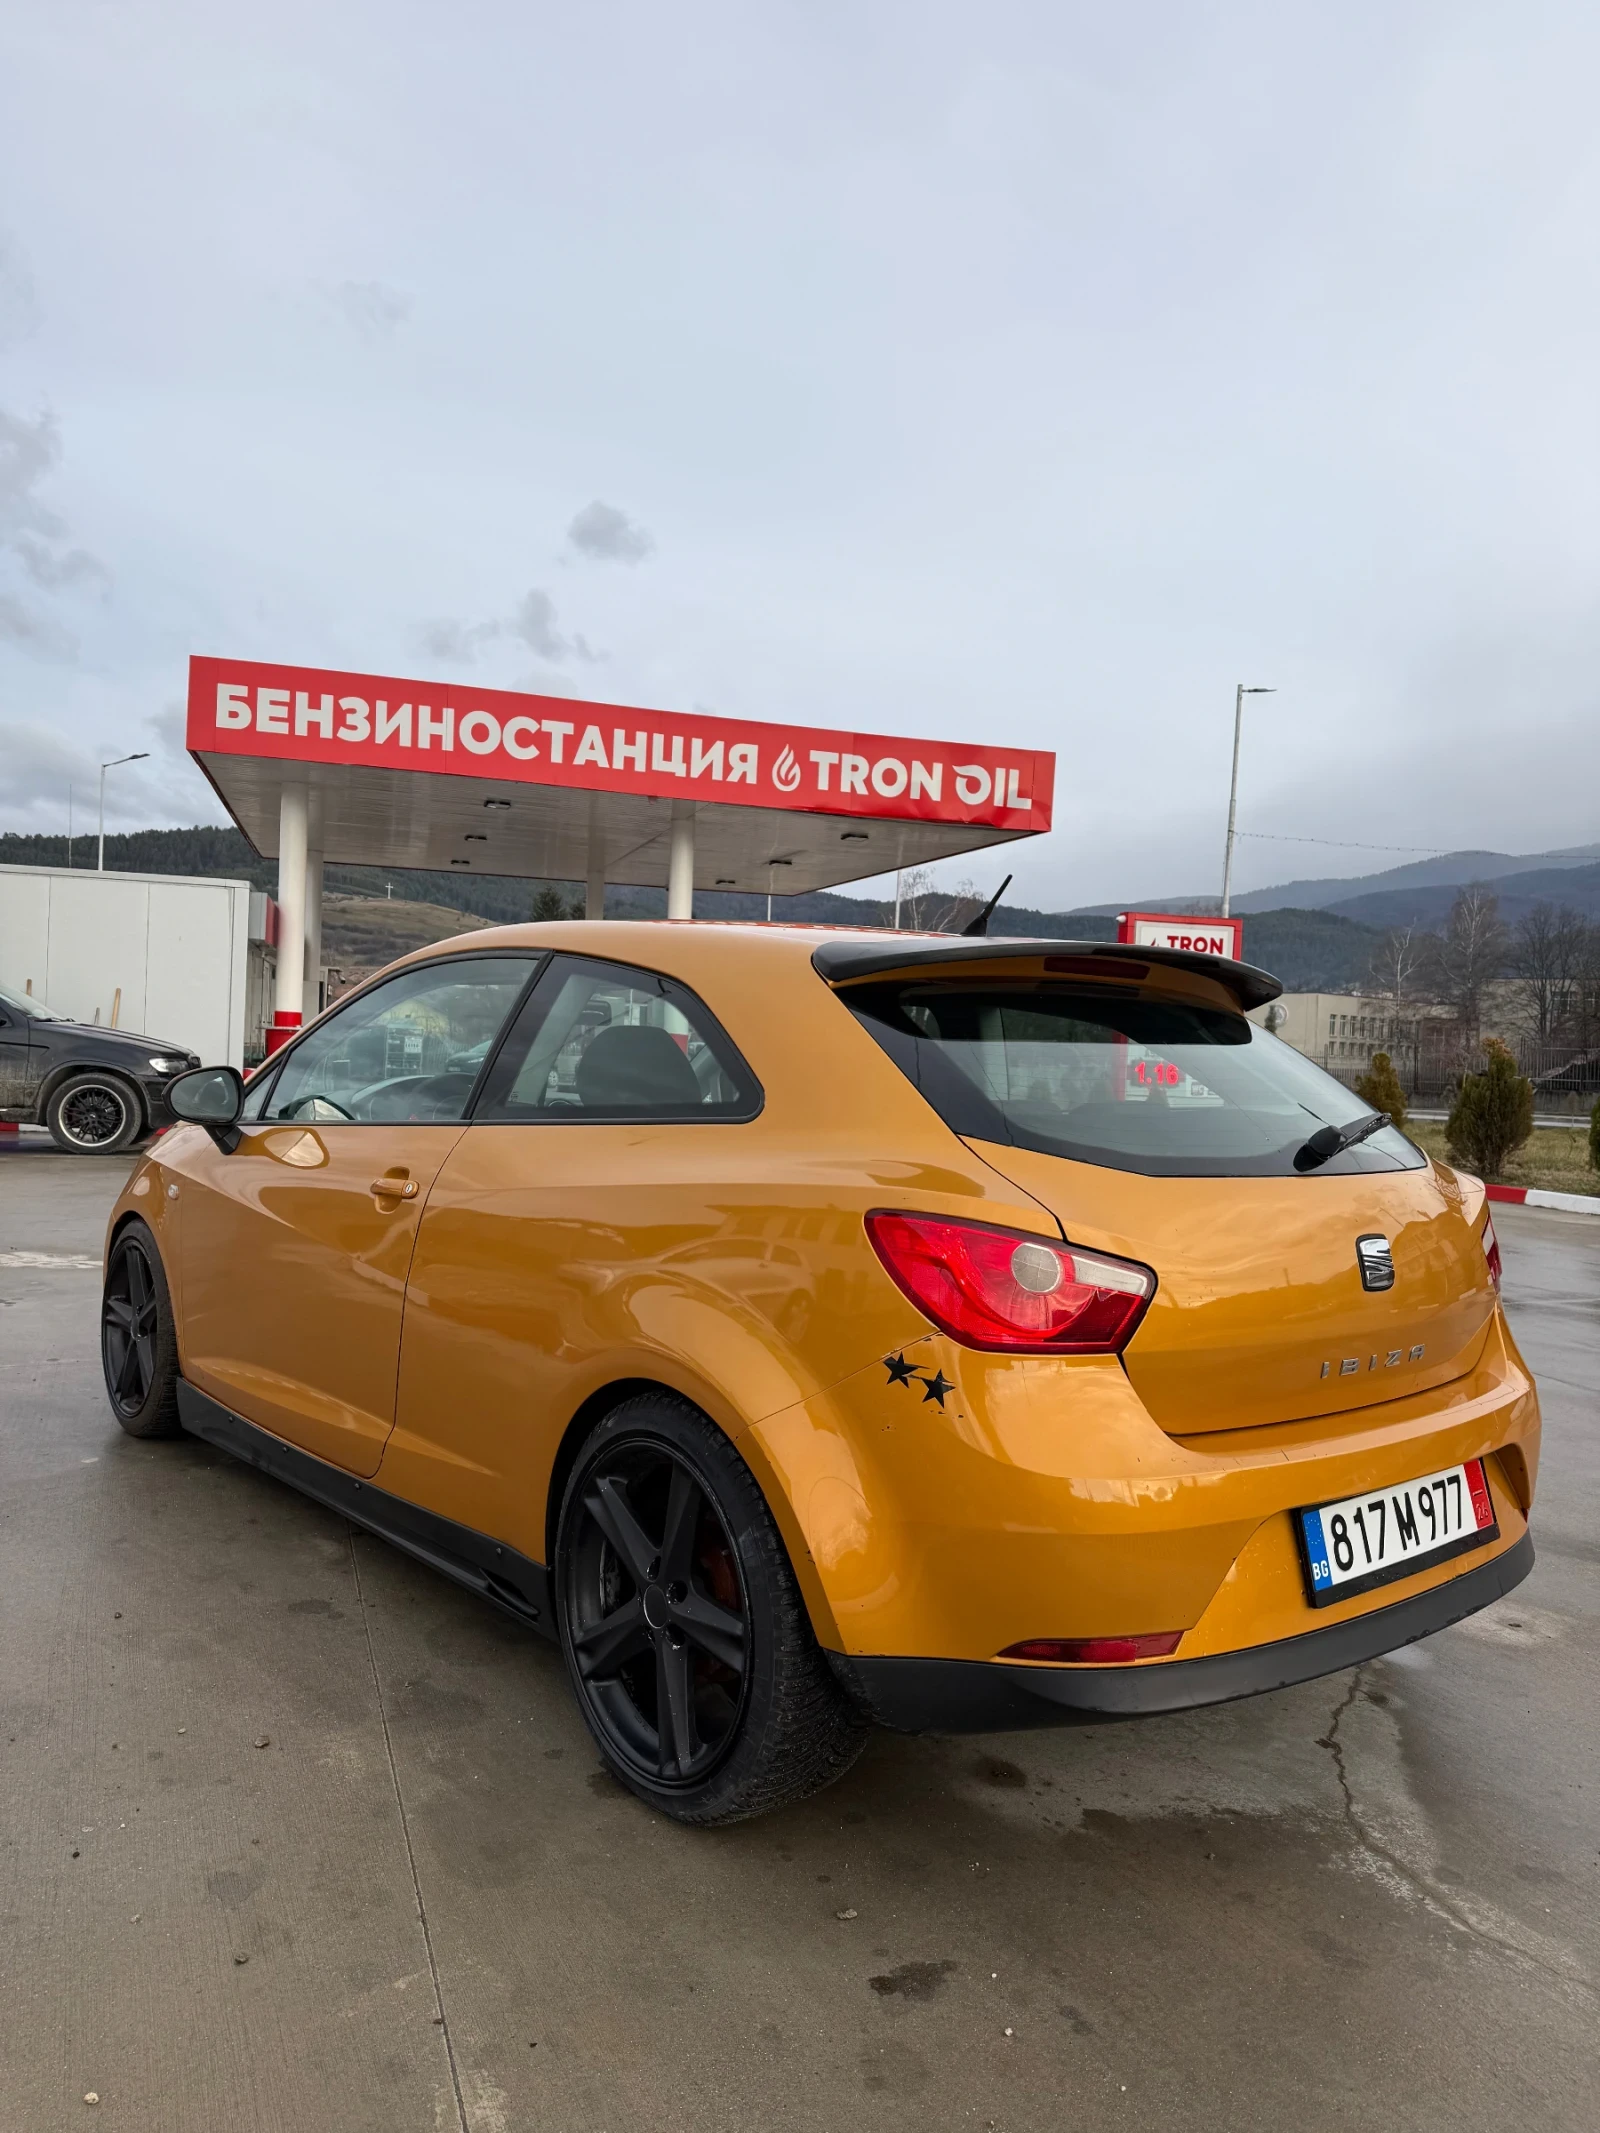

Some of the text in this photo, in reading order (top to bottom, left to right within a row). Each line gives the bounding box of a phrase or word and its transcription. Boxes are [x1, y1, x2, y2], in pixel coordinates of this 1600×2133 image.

[215, 683, 1033, 810] БЕНЗИНОСТАНЦИЯ TRON OIL
[1167, 935, 1224, 954] TRON
[1134, 1061, 1179, 1085] 1.16
[1320, 1344, 1425, 1378] IBIZA
[1312, 1561, 1329, 1581] BG
